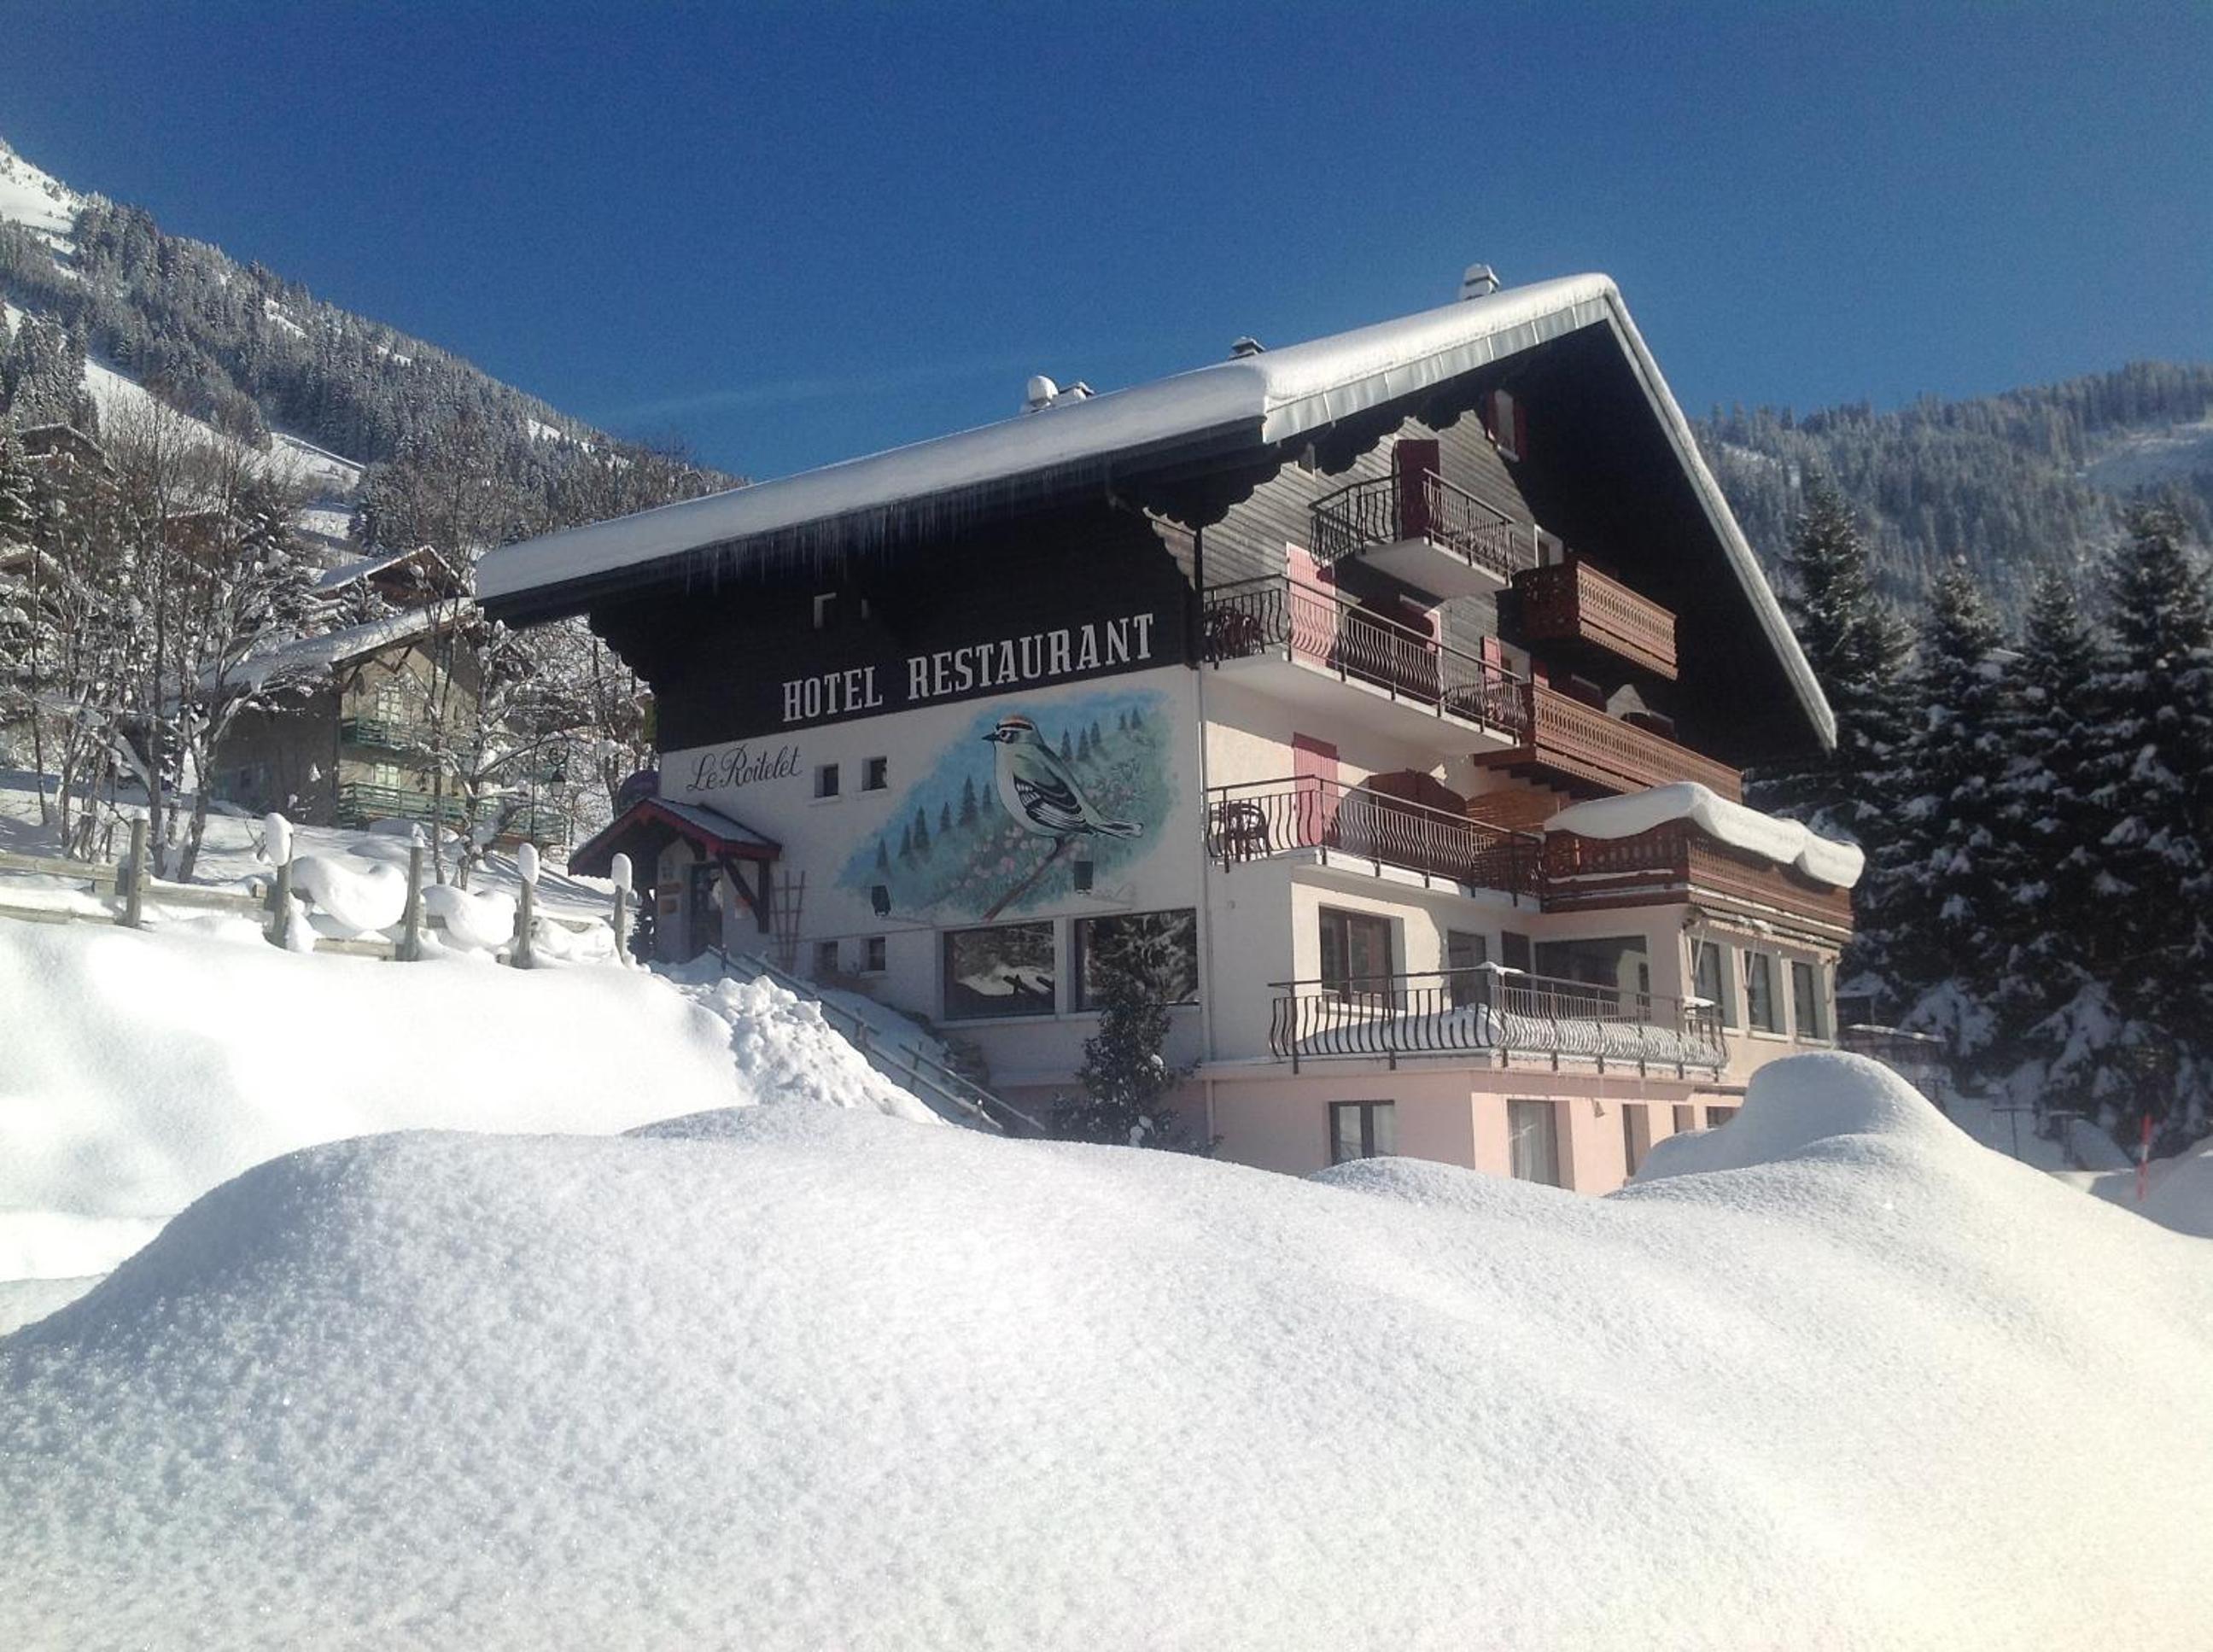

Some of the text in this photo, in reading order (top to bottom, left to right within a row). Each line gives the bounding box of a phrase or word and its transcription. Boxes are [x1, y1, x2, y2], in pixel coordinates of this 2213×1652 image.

[782, 613, 1153, 722] HOTEL RESTAURANT
[686, 743, 803, 791] Le Roitelet
